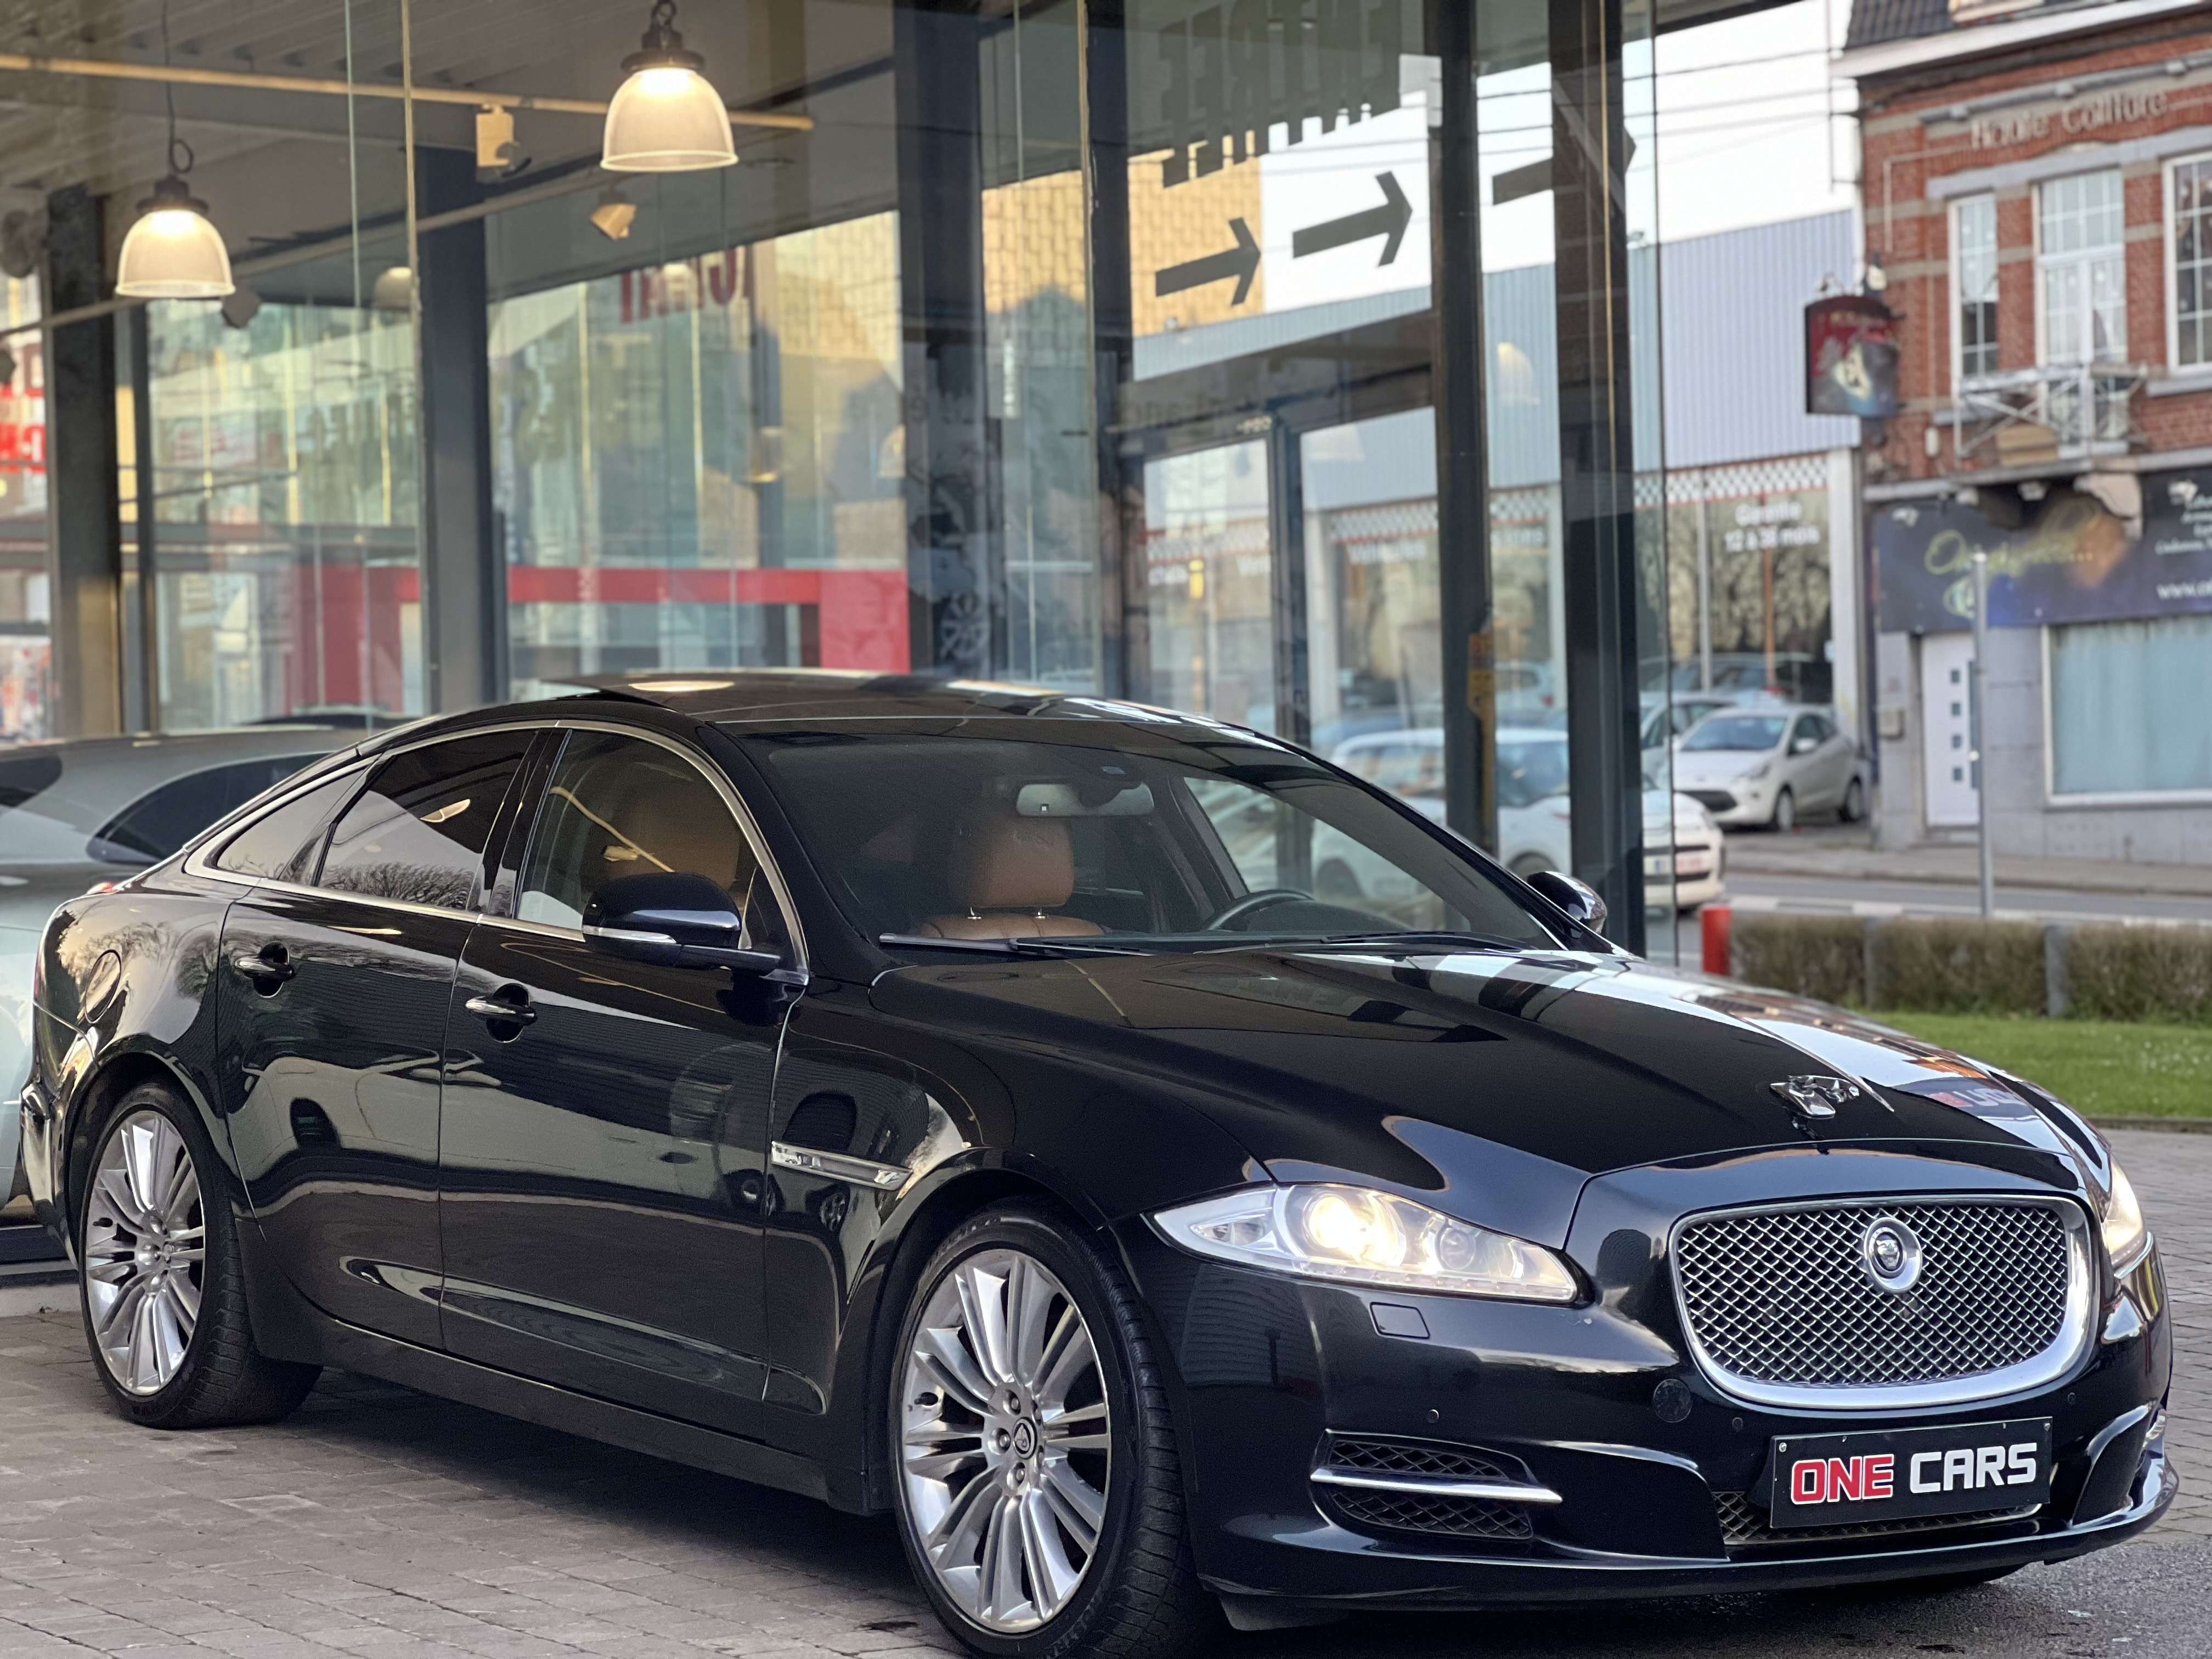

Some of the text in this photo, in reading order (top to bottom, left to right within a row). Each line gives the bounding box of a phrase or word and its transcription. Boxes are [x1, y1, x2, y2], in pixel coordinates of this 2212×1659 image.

[2061, 89, 2168, 134] Coiffure
[1791, 1442, 2037, 1505] ONE CARS
